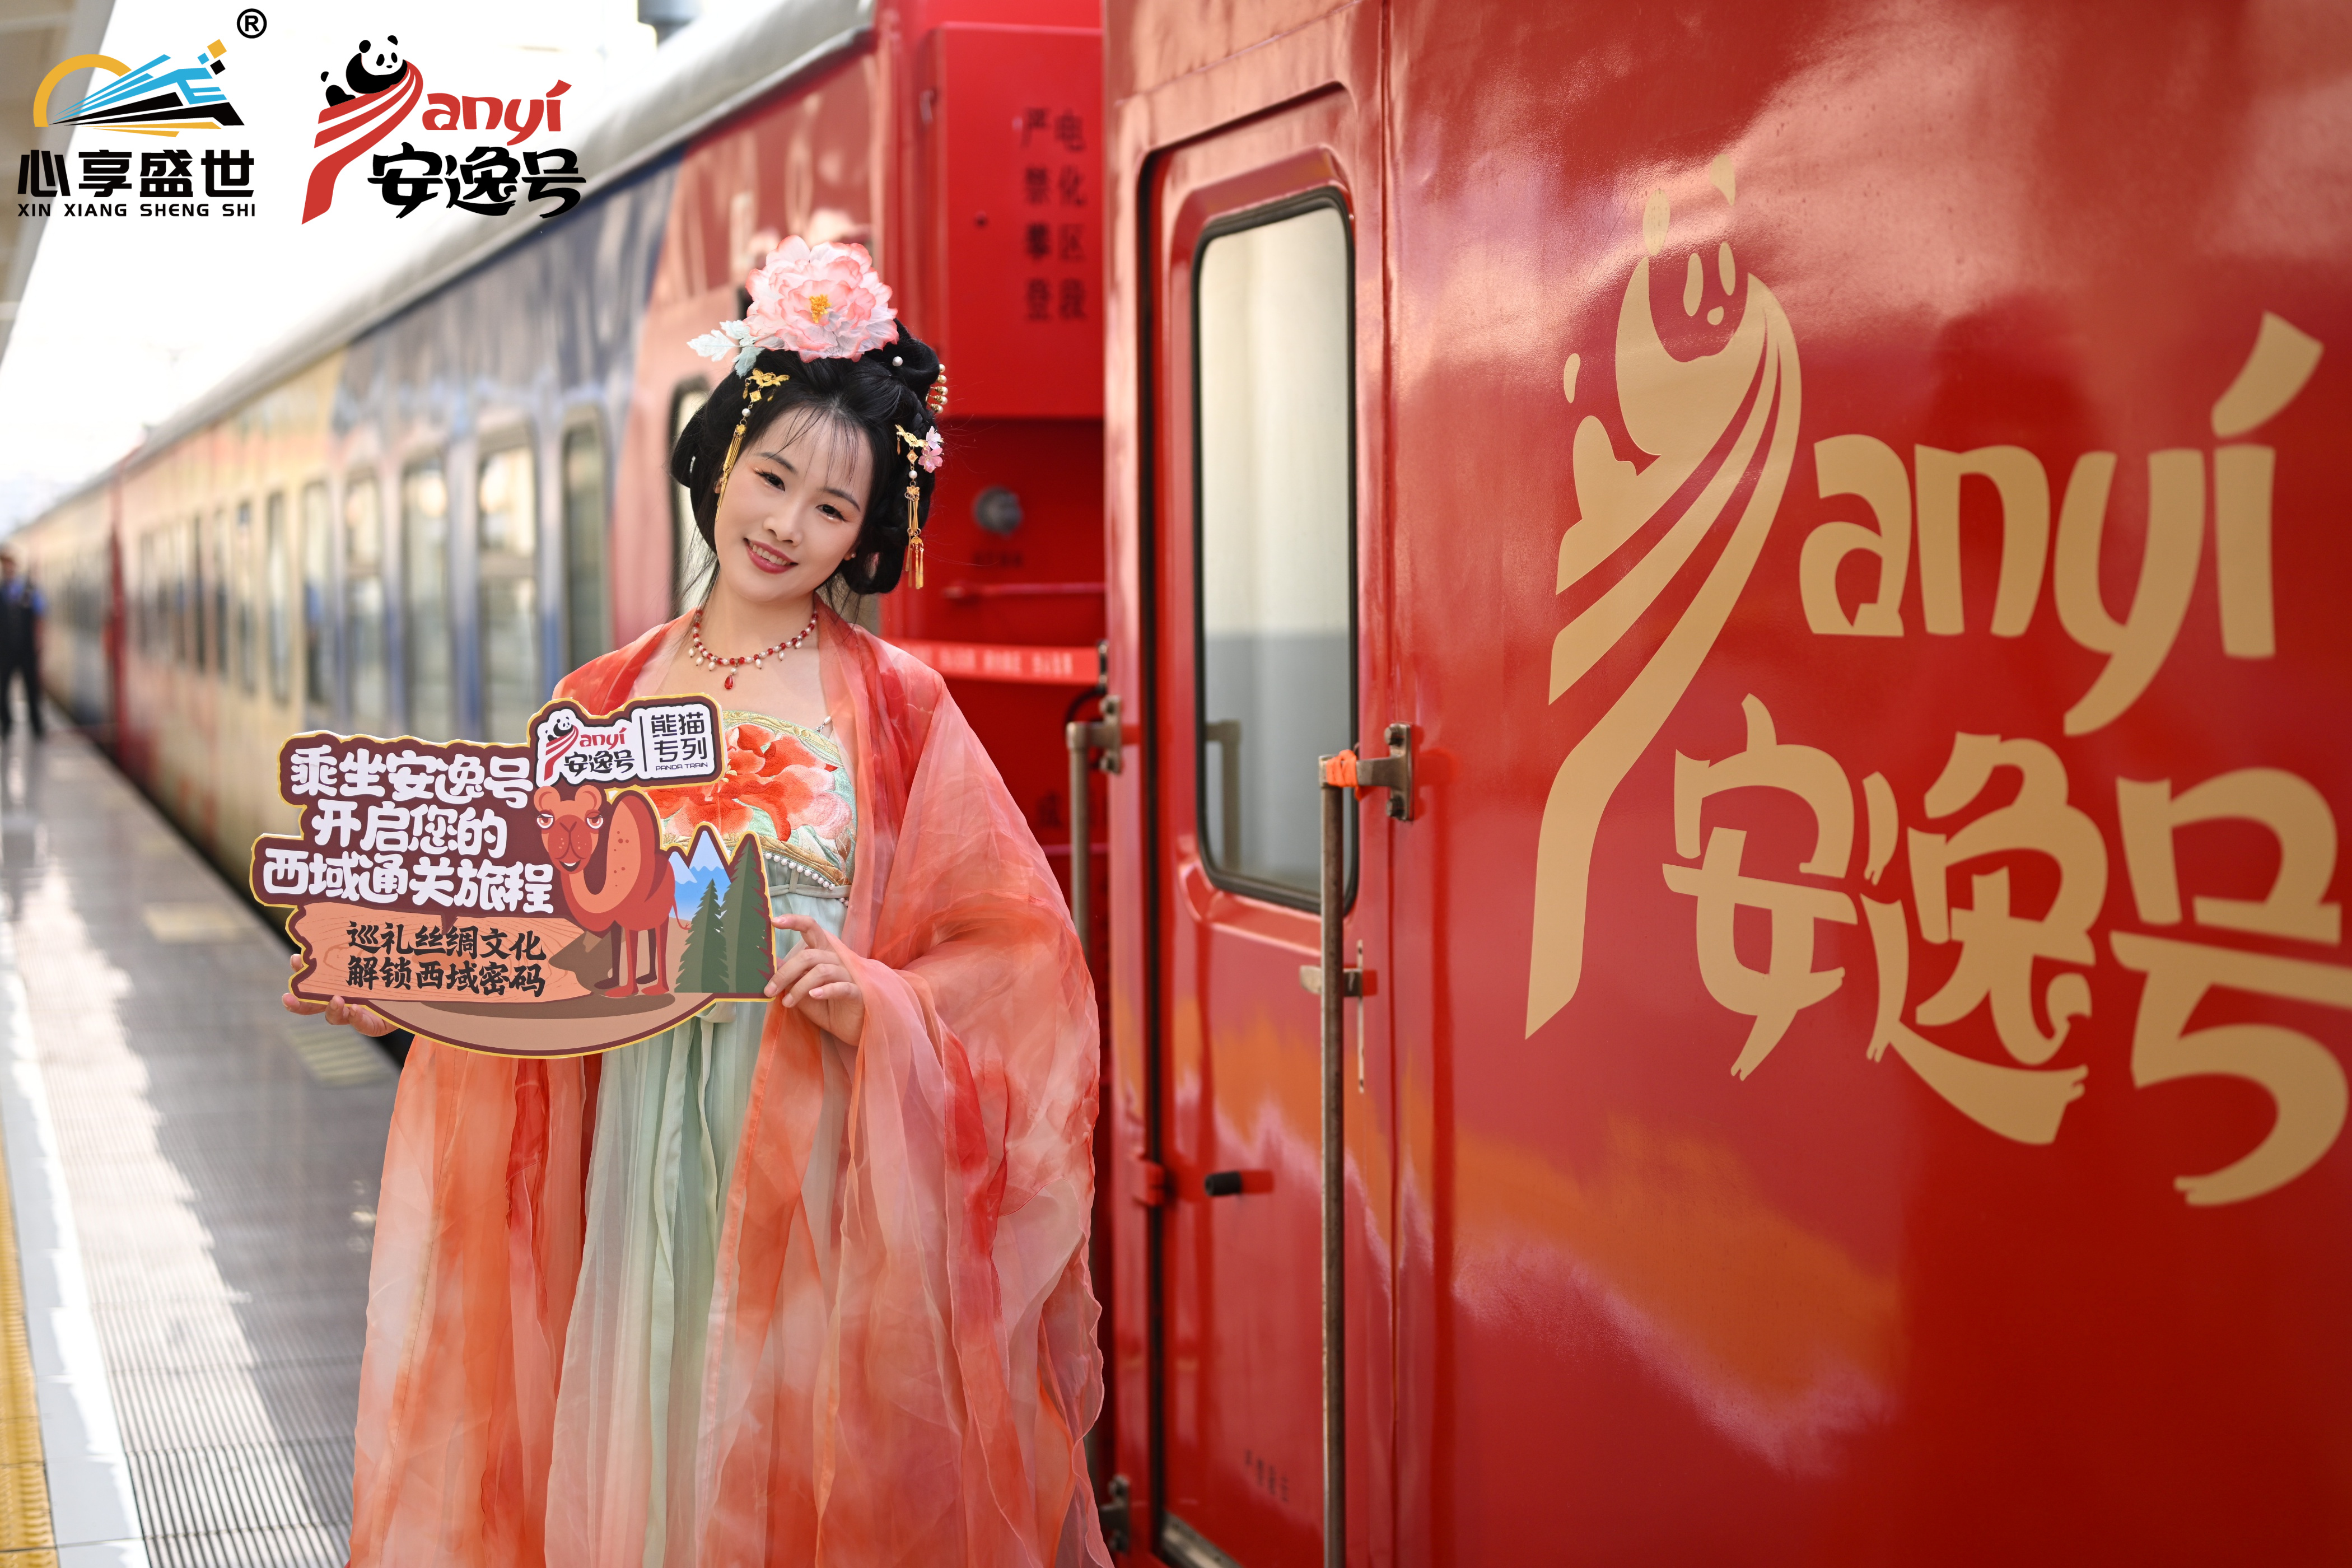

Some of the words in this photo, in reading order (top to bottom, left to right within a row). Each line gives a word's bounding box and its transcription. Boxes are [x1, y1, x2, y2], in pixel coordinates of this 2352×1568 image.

[651, 711, 705, 738] 熊猫
[563, 749, 635, 777] 安逸号
[653, 736, 707, 763] 专列
[290, 744, 534, 809] 乘坐安逸号
[311, 799, 507, 858] 开启您的
[263, 848, 554, 914] 西域通关旅程
[346, 921, 547, 961] 巡礼丝绸文化
[1662, 692, 2352, 1206] 安逸号
[346, 955, 546, 997] 解锁西域密码
